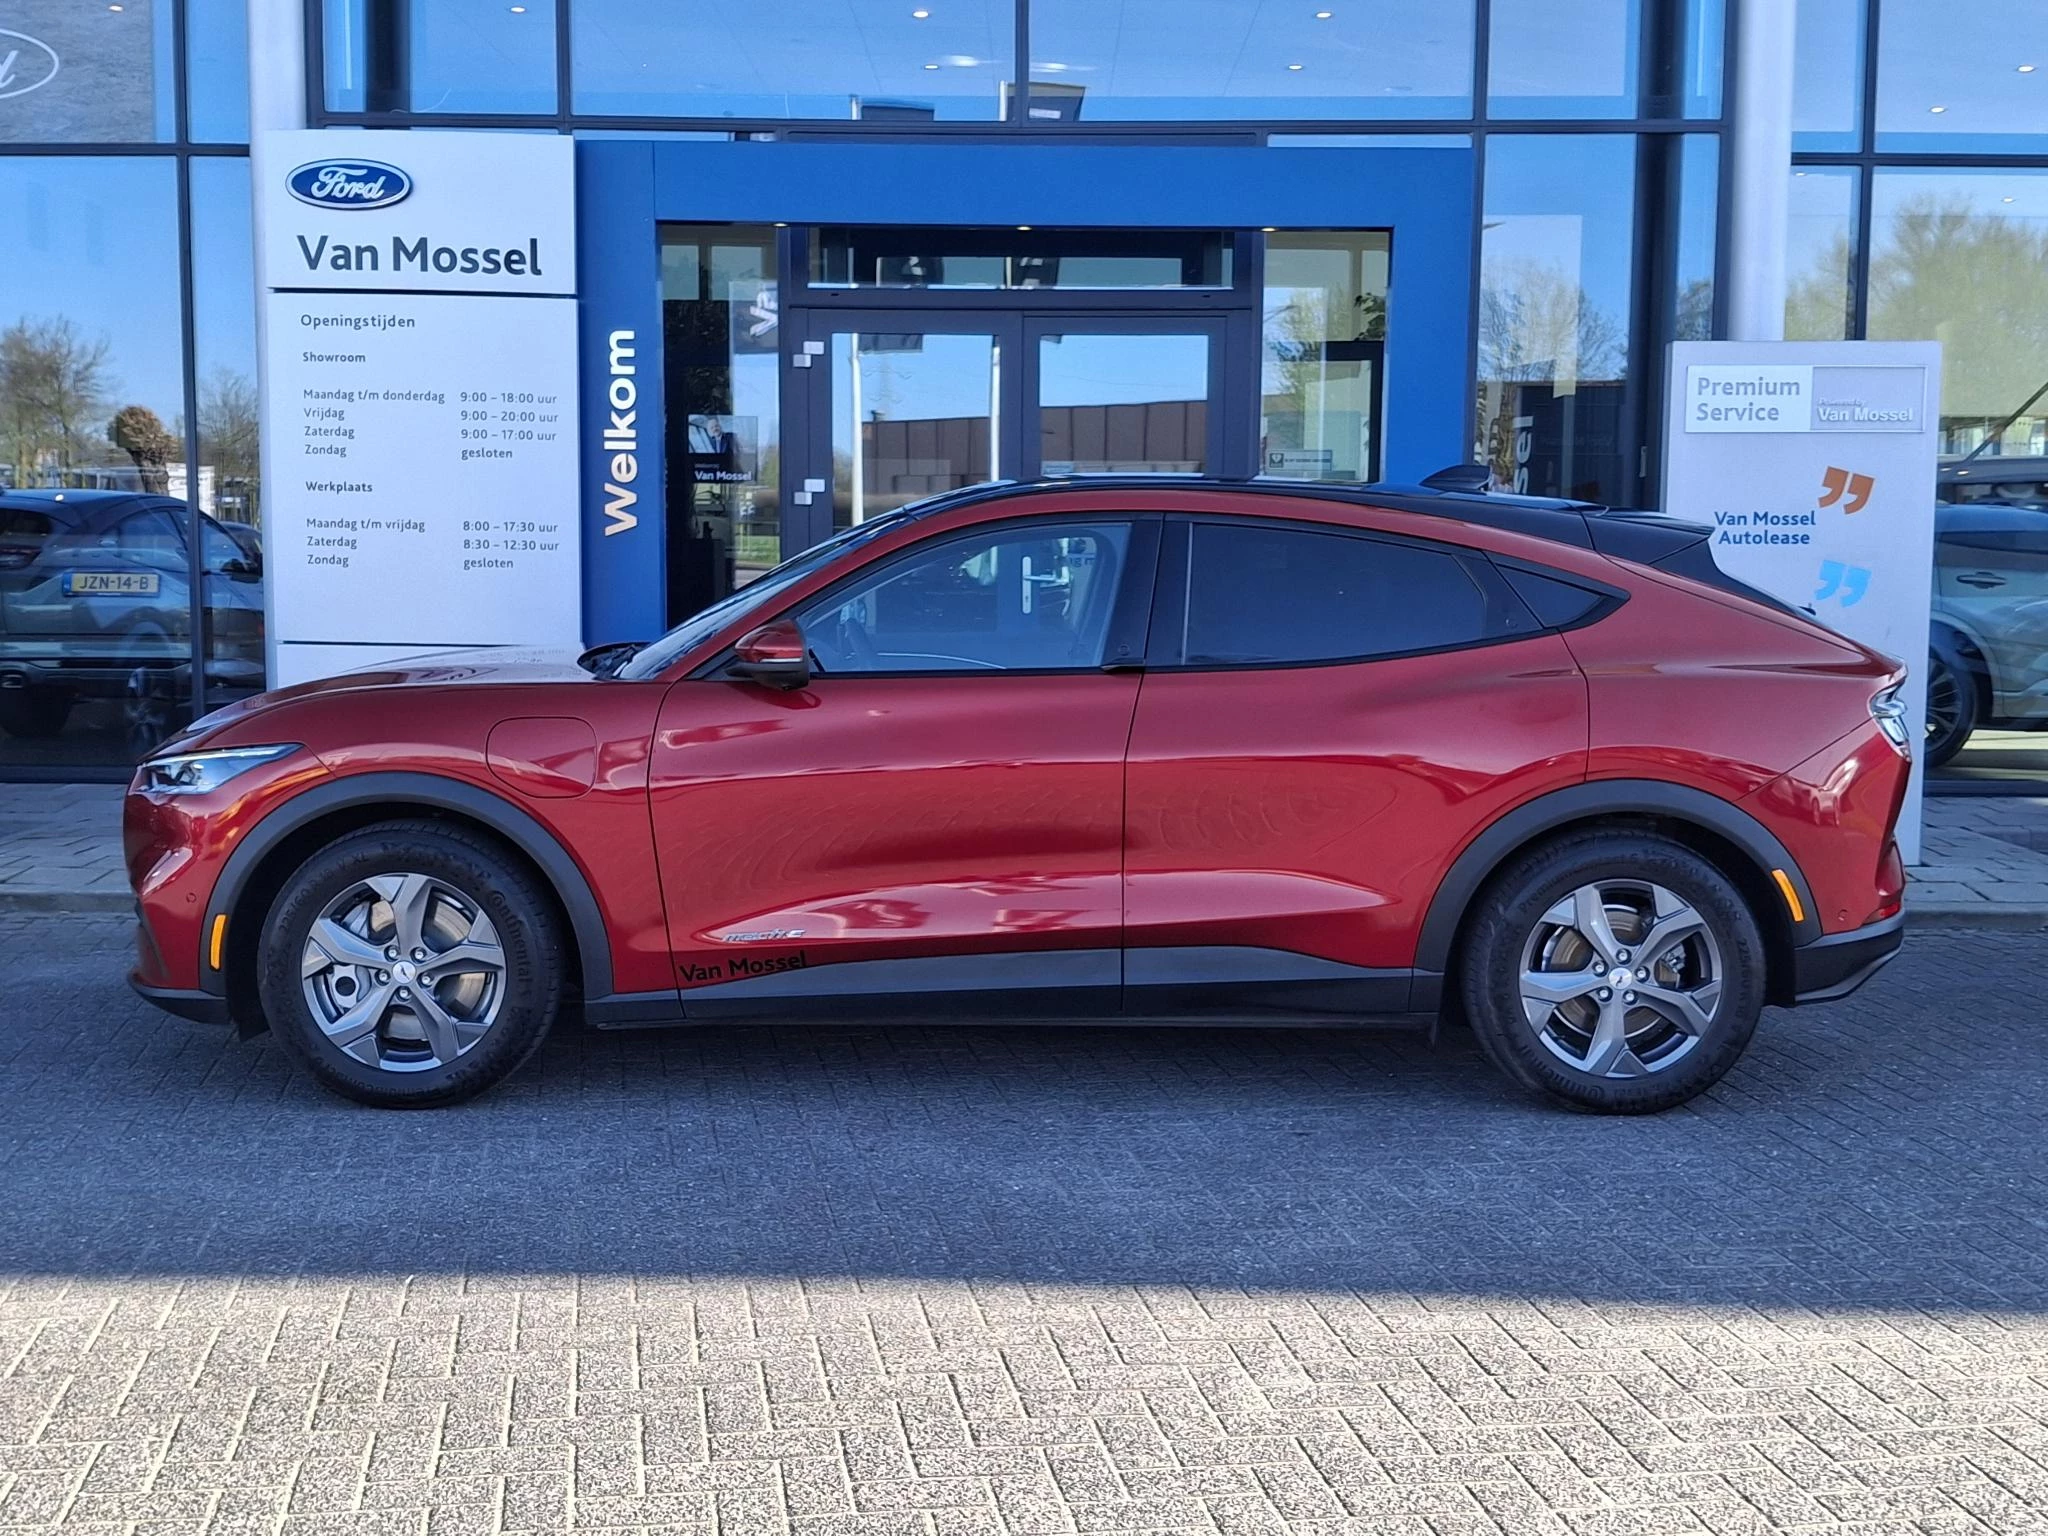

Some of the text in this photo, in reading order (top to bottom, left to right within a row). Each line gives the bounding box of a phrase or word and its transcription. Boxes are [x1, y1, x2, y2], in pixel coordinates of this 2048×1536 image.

[311, 166, 386, 200] Ford
[296, 234, 543, 276] Van Mossel
[300, 314, 415, 332] Openingstijden
[302, 351, 366, 363] Showroom
[1697, 376, 1801, 396] Premium
[303, 388, 446, 405] Maandag t/m donderdag
[460, 391, 487, 403] 9:00
[500, 392, 534, 404] 18:00
[537, 395, 558, 404] uur
[303, 407, 345, 422] Vrijdag
[460, 409, 488, 421] 9:00
[500, 410, 536, 423] 20:00
[538, 414, 559, 423] uur
[1696, 401, 1780, 422] Service
[1818, 407, 1913, 423] Van Mossel
[304, 425, 355, 440] Zaterdag
[460, 428, 488, 440] 9:00
[501, 429, 534, 441] 17:00
[536, 432, 557, 441] uur
[603, 329, 638, 538] Welkom
[304, 443, 347, 458] Zondag
[461, 447, 513, 461] gesloten
[694, 470, 752, 481] Van Mossel
[305, 480, 373, 495] Werkplaats
[306, 517, 426, 534] Maandag t/m vrijdag
[1714, 510, 1817, 526] Van Mossel
[463, 520, 490, 532] 8:00
[503, 521, 535, 533] 17:30
[538, 524, 559, 533] uur
[307, 535, 358, 550] Zaterdag
[463, 538, 490, 550] 8:30
[503, 539, 537, 551] 12:30
[539, 543, 560, 551] uur
[1718, 529, 1811, 545] Autolease
[307, 554, 349, 569] Zondag
[463, 557, 514, 571] gesloten
[79, 574, 149, 590] JZN-14-B
[679, 948, 808, 983] Van Mossel
